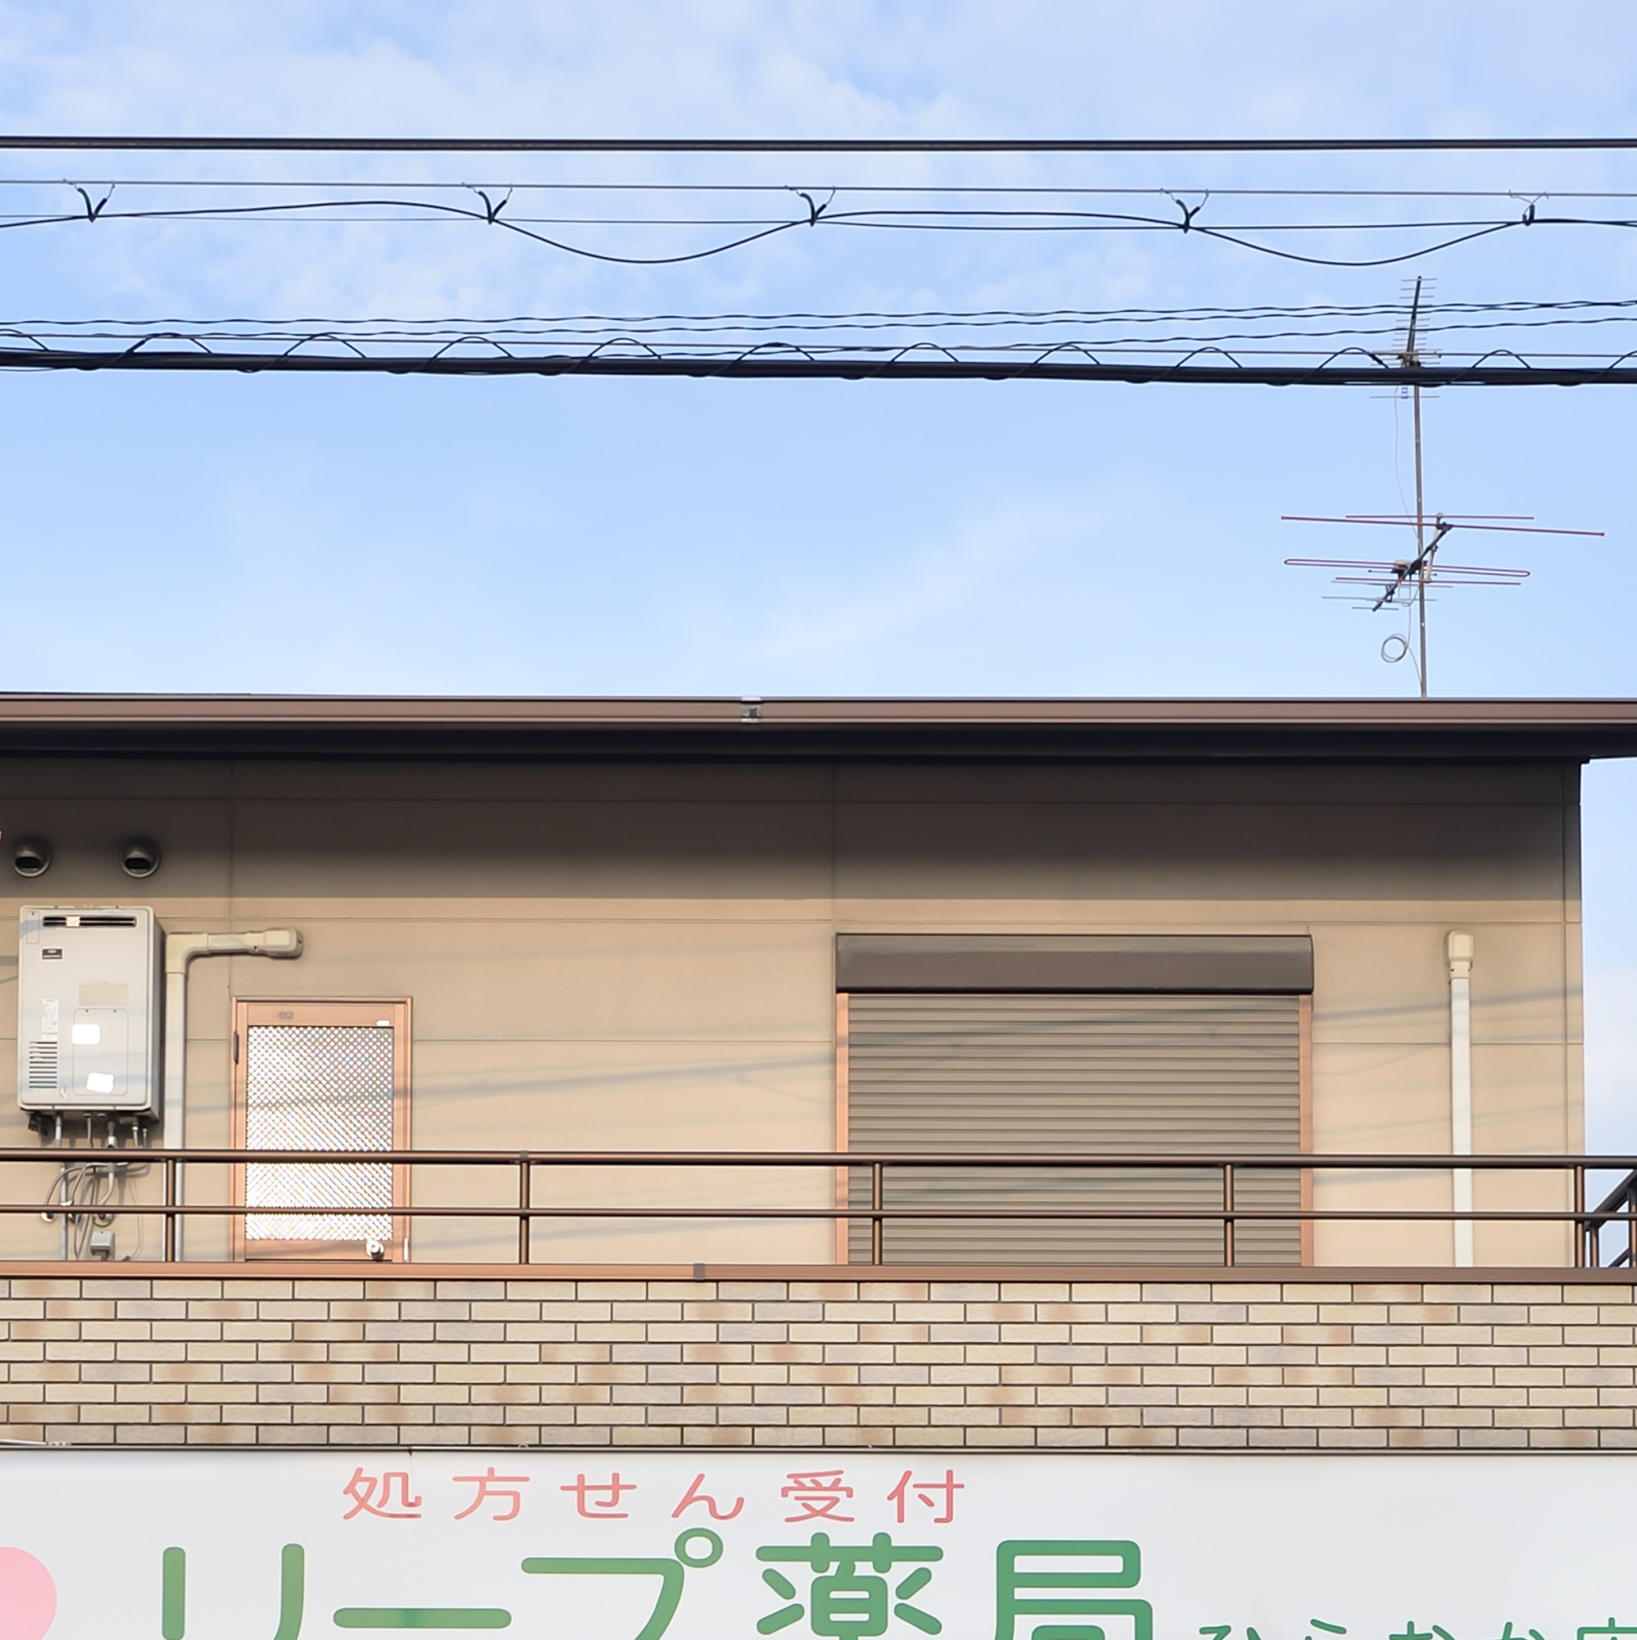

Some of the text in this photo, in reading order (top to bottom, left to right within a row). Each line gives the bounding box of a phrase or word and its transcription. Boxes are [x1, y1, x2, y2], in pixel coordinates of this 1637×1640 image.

[342, 1466, 966, 1524] 処方せん受付
